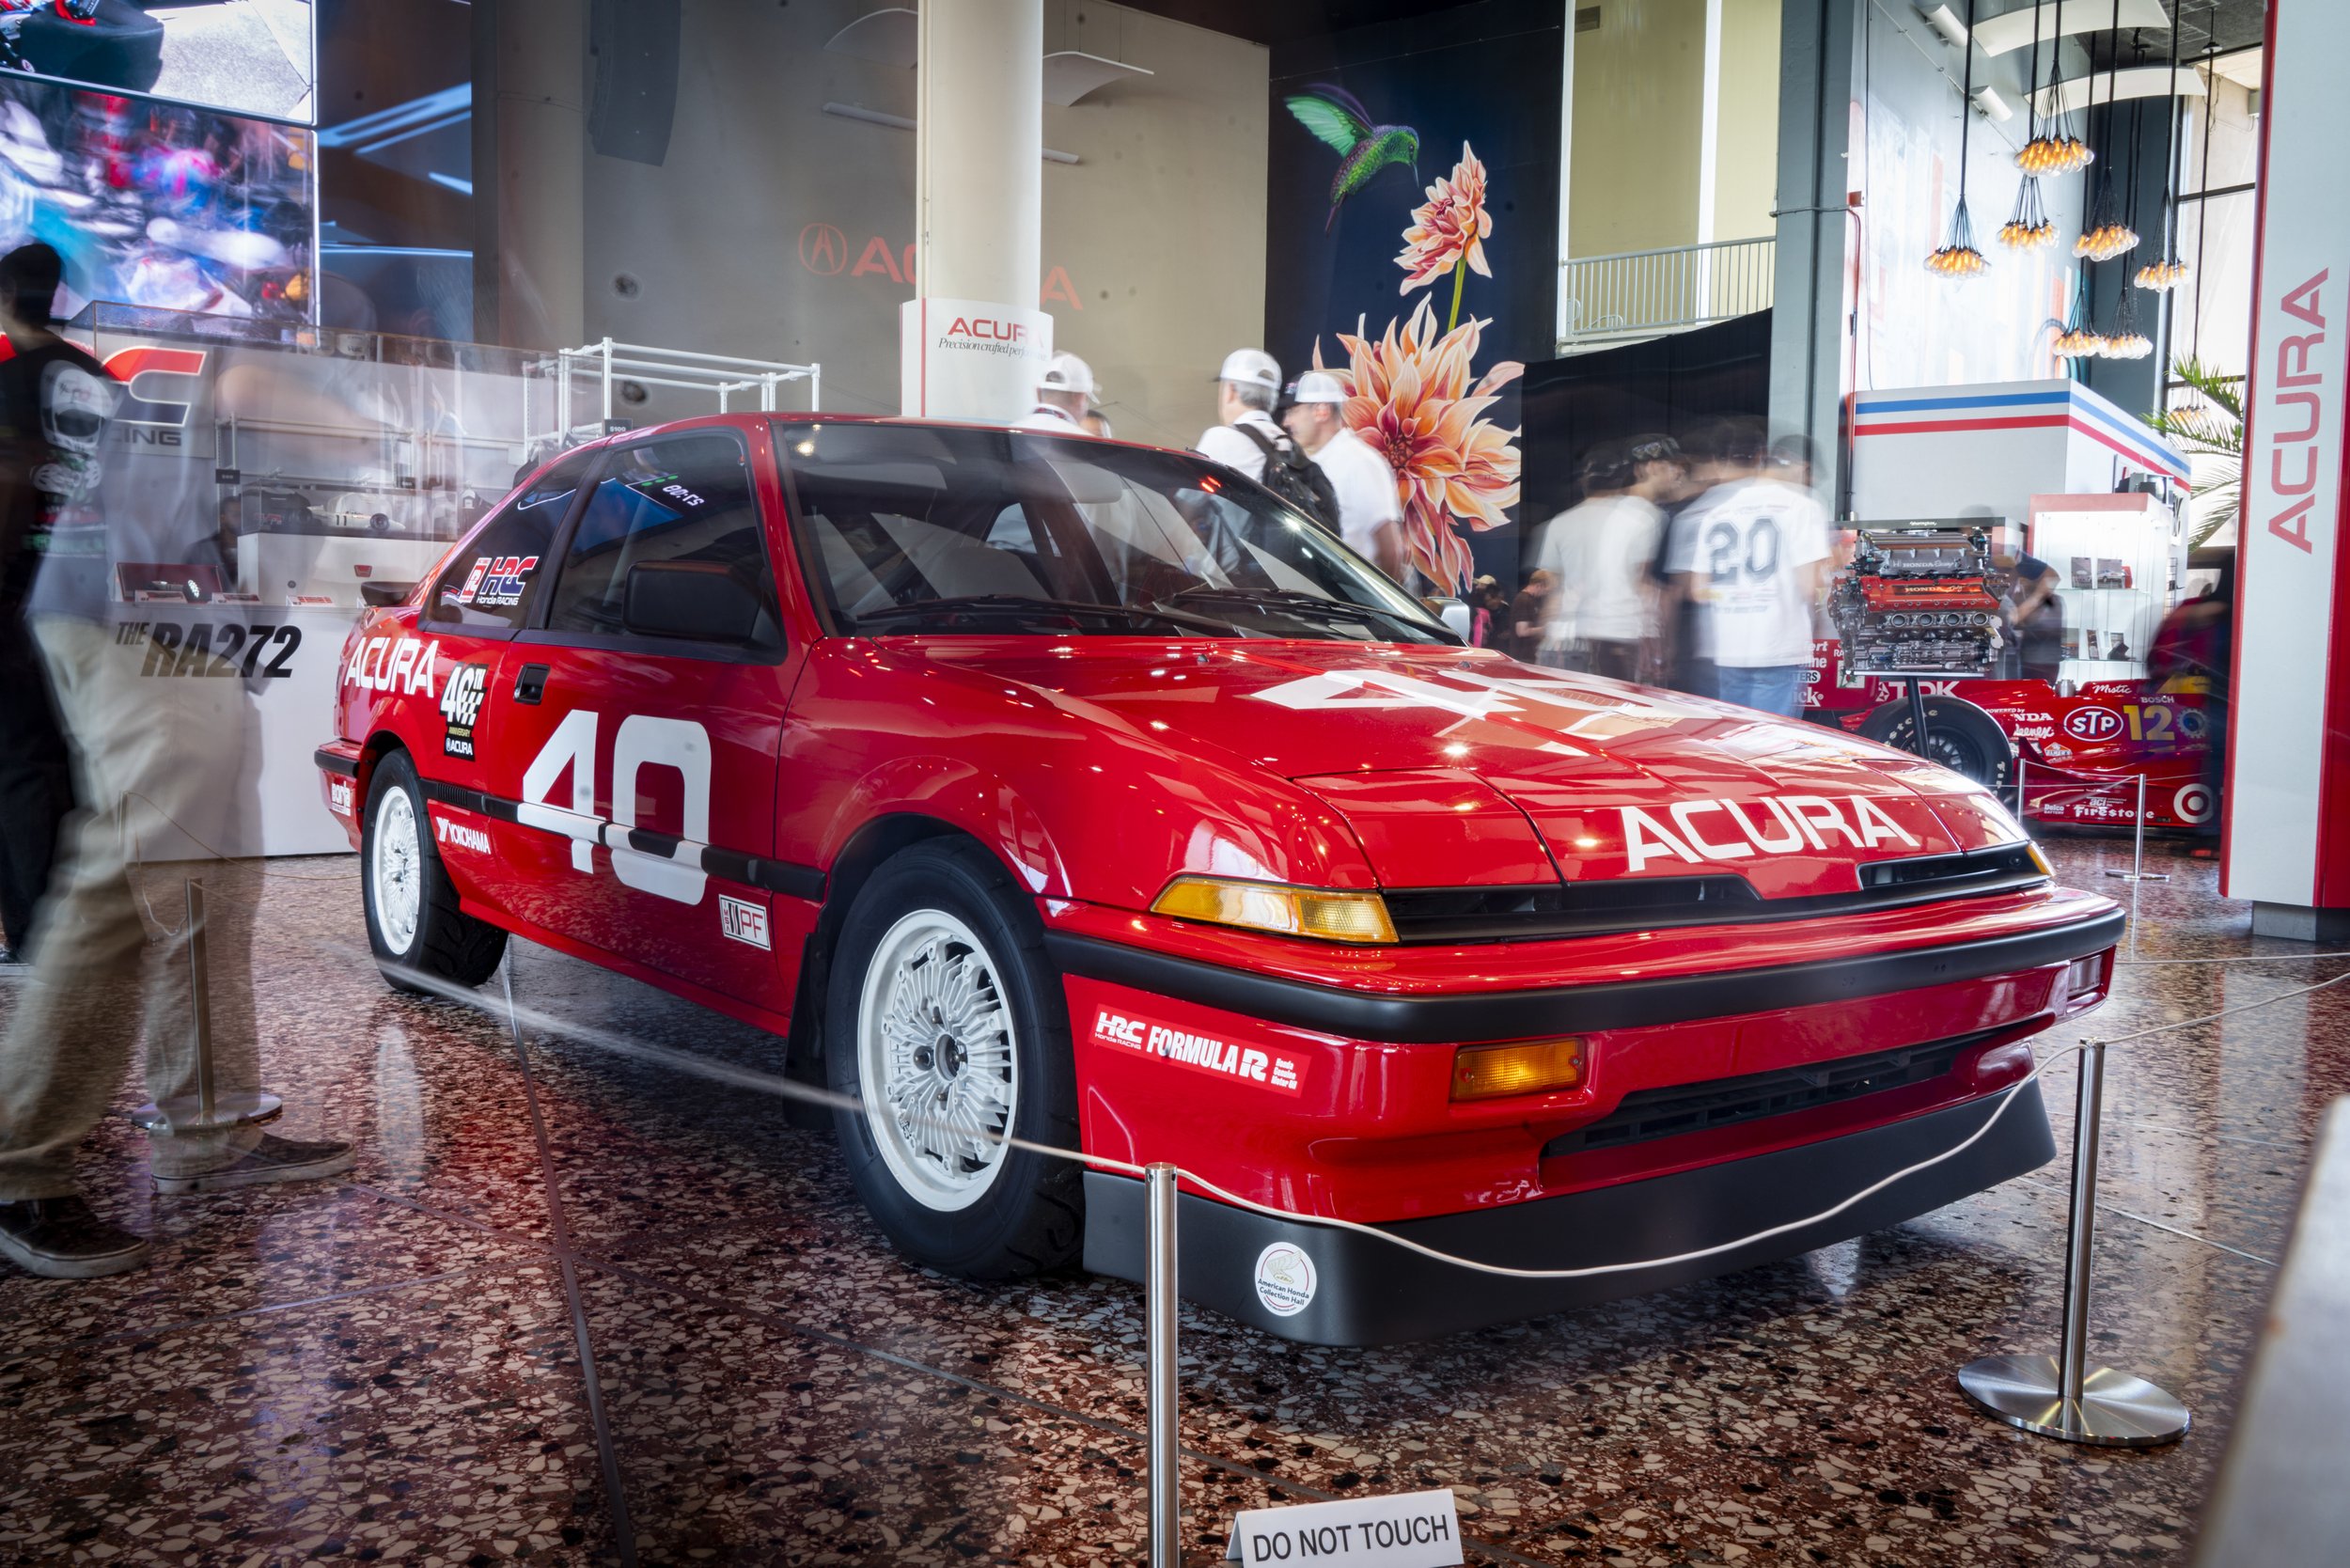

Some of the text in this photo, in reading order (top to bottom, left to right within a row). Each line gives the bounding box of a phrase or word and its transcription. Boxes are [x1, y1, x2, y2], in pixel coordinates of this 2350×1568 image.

[938, 337, 979, 351] Precision
[980, 340, 1009, 354] crafted
[948, 317, 1044, 348] ACUR
[2268, 267, 2328, 555] ACURA
[1705, 516, 1782, 586] 20
[479, 557, 539, 596] HRC
[477, 596, 496, 604] Honda
[496, 596, 519, 605] RACING
[116, 621, 303, 679] THE RA272
[345, 636, 439, 698] ACURA
[2013, 723, 2056, 739] leenex
[2072, 711, 2115, 735] STP
[2123, 705, 2175, 741] 12
[451, 739, 474, 756] ACURA
[517, 709, 712, 905] 40
[2074, 805, 2154, 819] Firestoe
[447, 822, 492, 855] YOKOHAMA
[1620, 795, 1921, 872] ACURA
[1094, 1031, 1142, 1050] Honda RACING
[1095, 1011, 1269, 1082] HRC FORMULA R
[1273, 1066, 1296, 1080] Genuine
[1275, 1057, 1294, 1071] Honda
[1270, 1074, 1298, 1090] Motor Oil
[1258, 1278, 1286, 1293] American
[1287, 1287, 1309, 1299] Honda
[1260, 1286, 1290, 1302] Collection
[1291, 1296, 1305, 1306] Hall
[1253, 1514, 1449, 1562] DO NOT TOUCH
